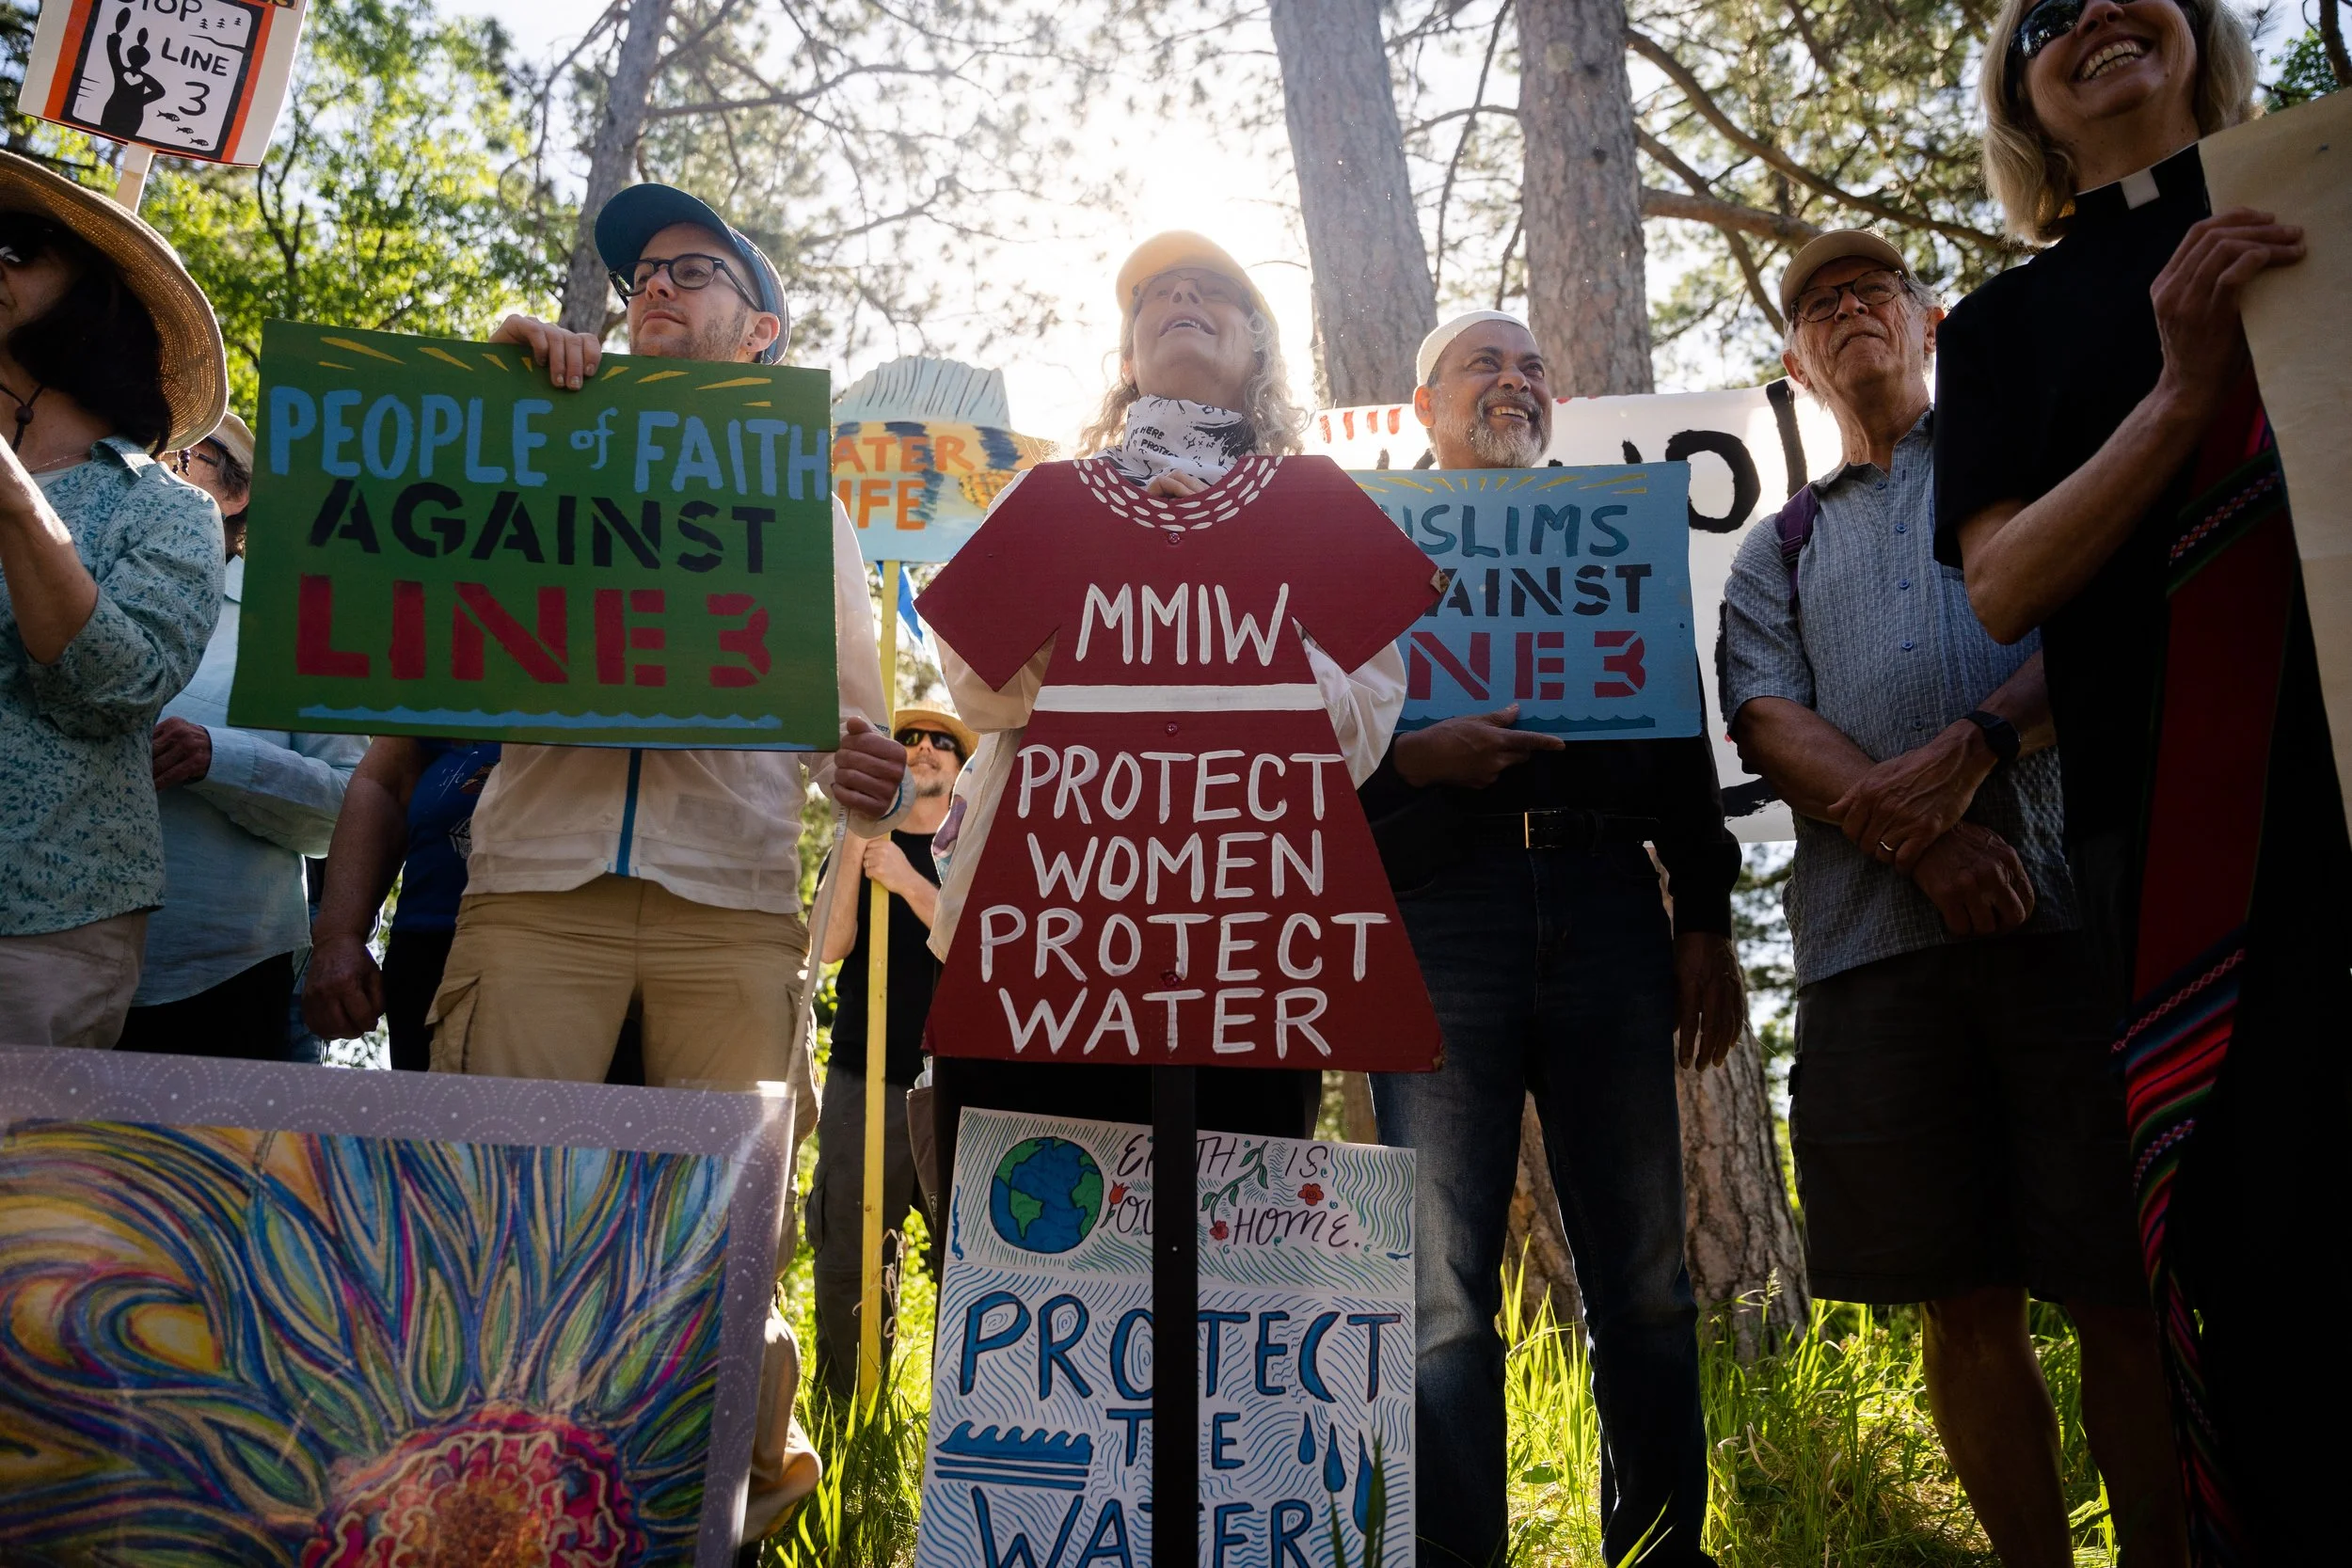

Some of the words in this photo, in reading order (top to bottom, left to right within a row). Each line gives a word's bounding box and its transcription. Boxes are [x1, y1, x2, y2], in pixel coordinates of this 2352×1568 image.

[118, 0, 202, 22] OP
[161, 38, 230, 76] LINE
[177, 81, 211, 116] 3
[270, 386, 554, 486] PEOPLE
[570, 406, 619, 469] of
[633, 410, 828, 500] FAITH
[832, 436, 975, 473] ATER
[1139, 426, 1165, 439] HERE
[1140, 438, 1179, 458] PROTE
[308, 478, 776, 573] AGAINST
[837, 479, 927, 531] IFE
[1402, 503, 1629, 558] SLIMS
[1423, 563, 1652, 617] AINST
[295, 573, 666, 688] LINE
[707, 593, 771, 688] 3
[1075, 583, 1289, 666] MMIW
[1407, 631, 1565, 701] NE
[1594, 630, 1646, 698] 3
[1017, 745, 1344, 825] PROTECT
[1028, 830, 1324, 904] WOMEN
[979, 904, 1391, 982] PROTECT
[998, 987, 1332, 1059] WATER
[1117, 1134, 1234, 1178] ETH
[1285, 1146, 1327, 1178] IS
[959, 1291, 1401, 1403] PROTECT
[1105, 1408, 1246, 1470] TE
[971, 1485, 1313, 1568] WAER
